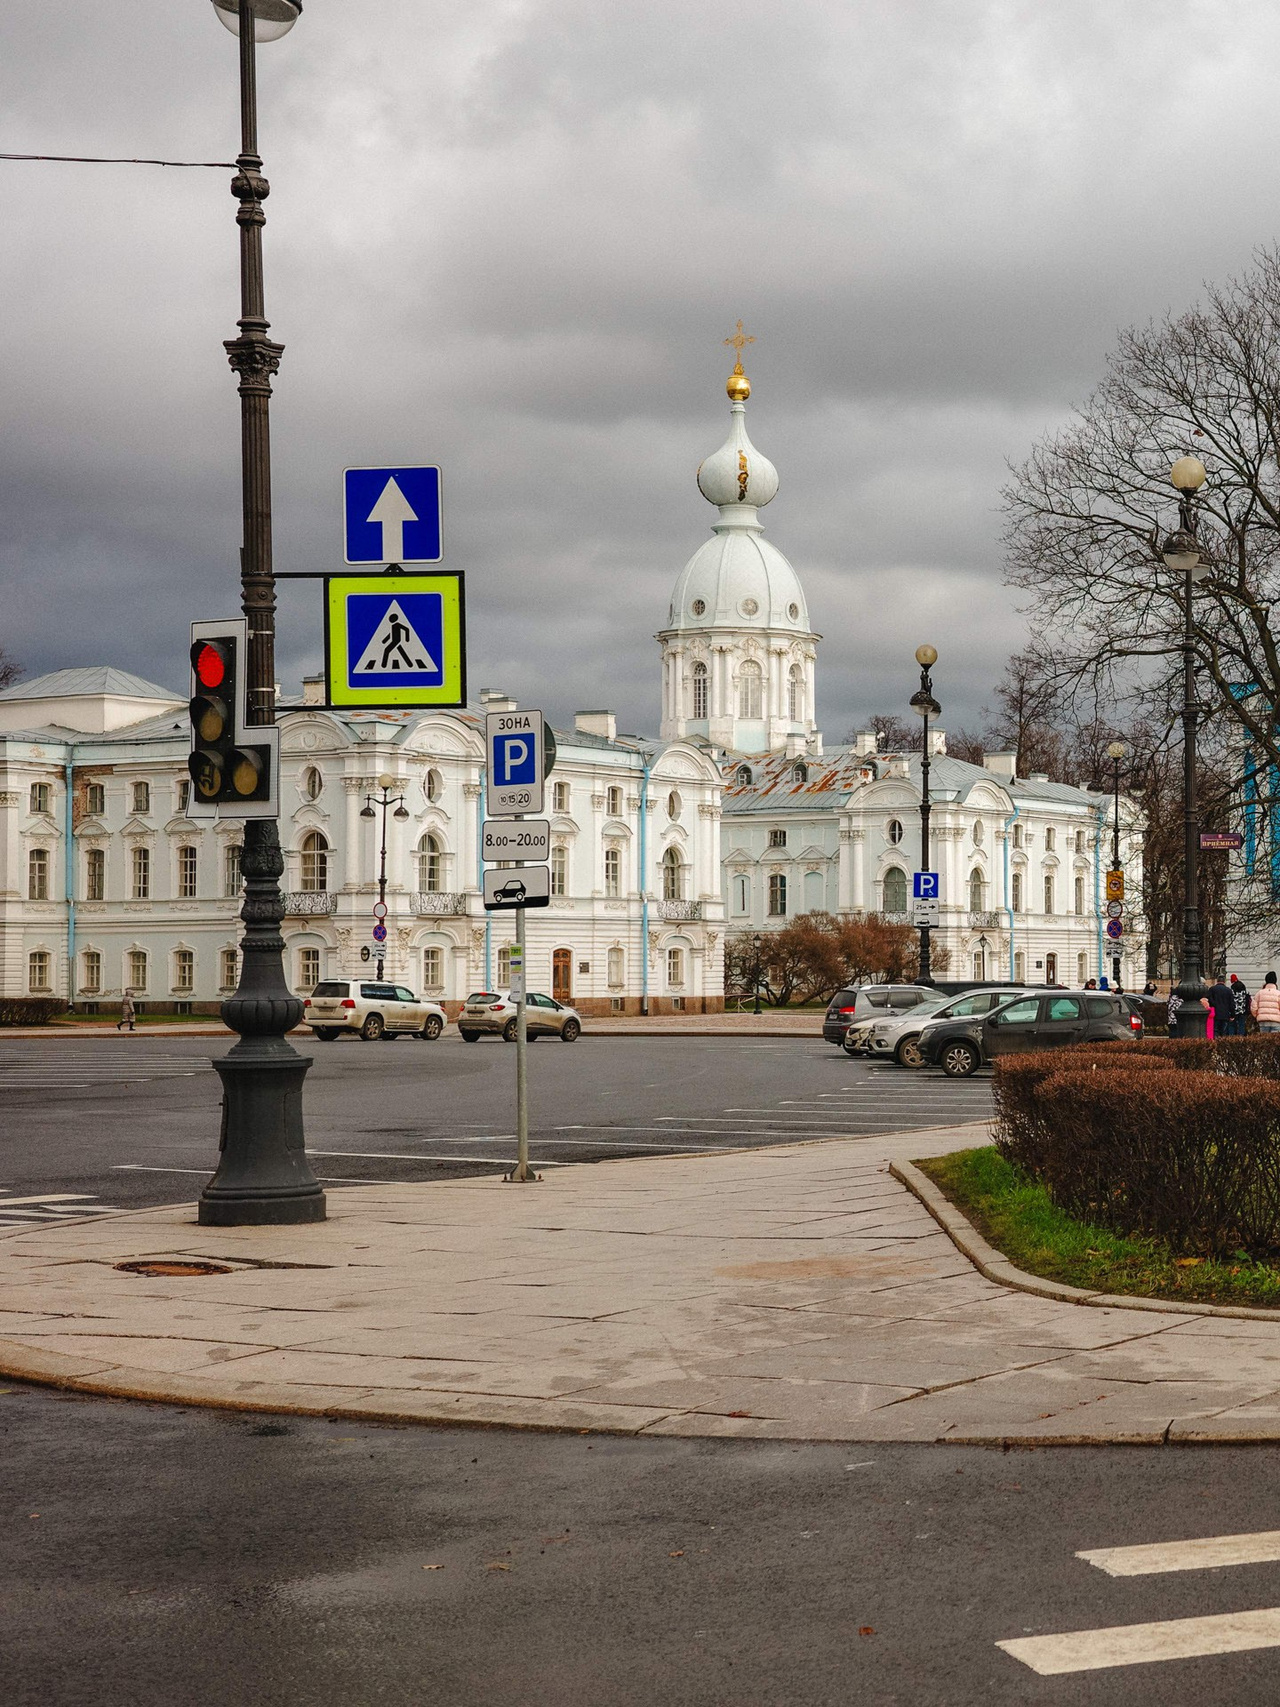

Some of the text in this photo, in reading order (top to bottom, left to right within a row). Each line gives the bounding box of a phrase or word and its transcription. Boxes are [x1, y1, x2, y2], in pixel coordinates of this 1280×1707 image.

[498, 717, 531, 730] ЗОНА
[504, 739, 529, 781] P
[508, 795, 516, 804] 15
[518, 793, 530, 803] 20
[920, 875, 935, 896] P
